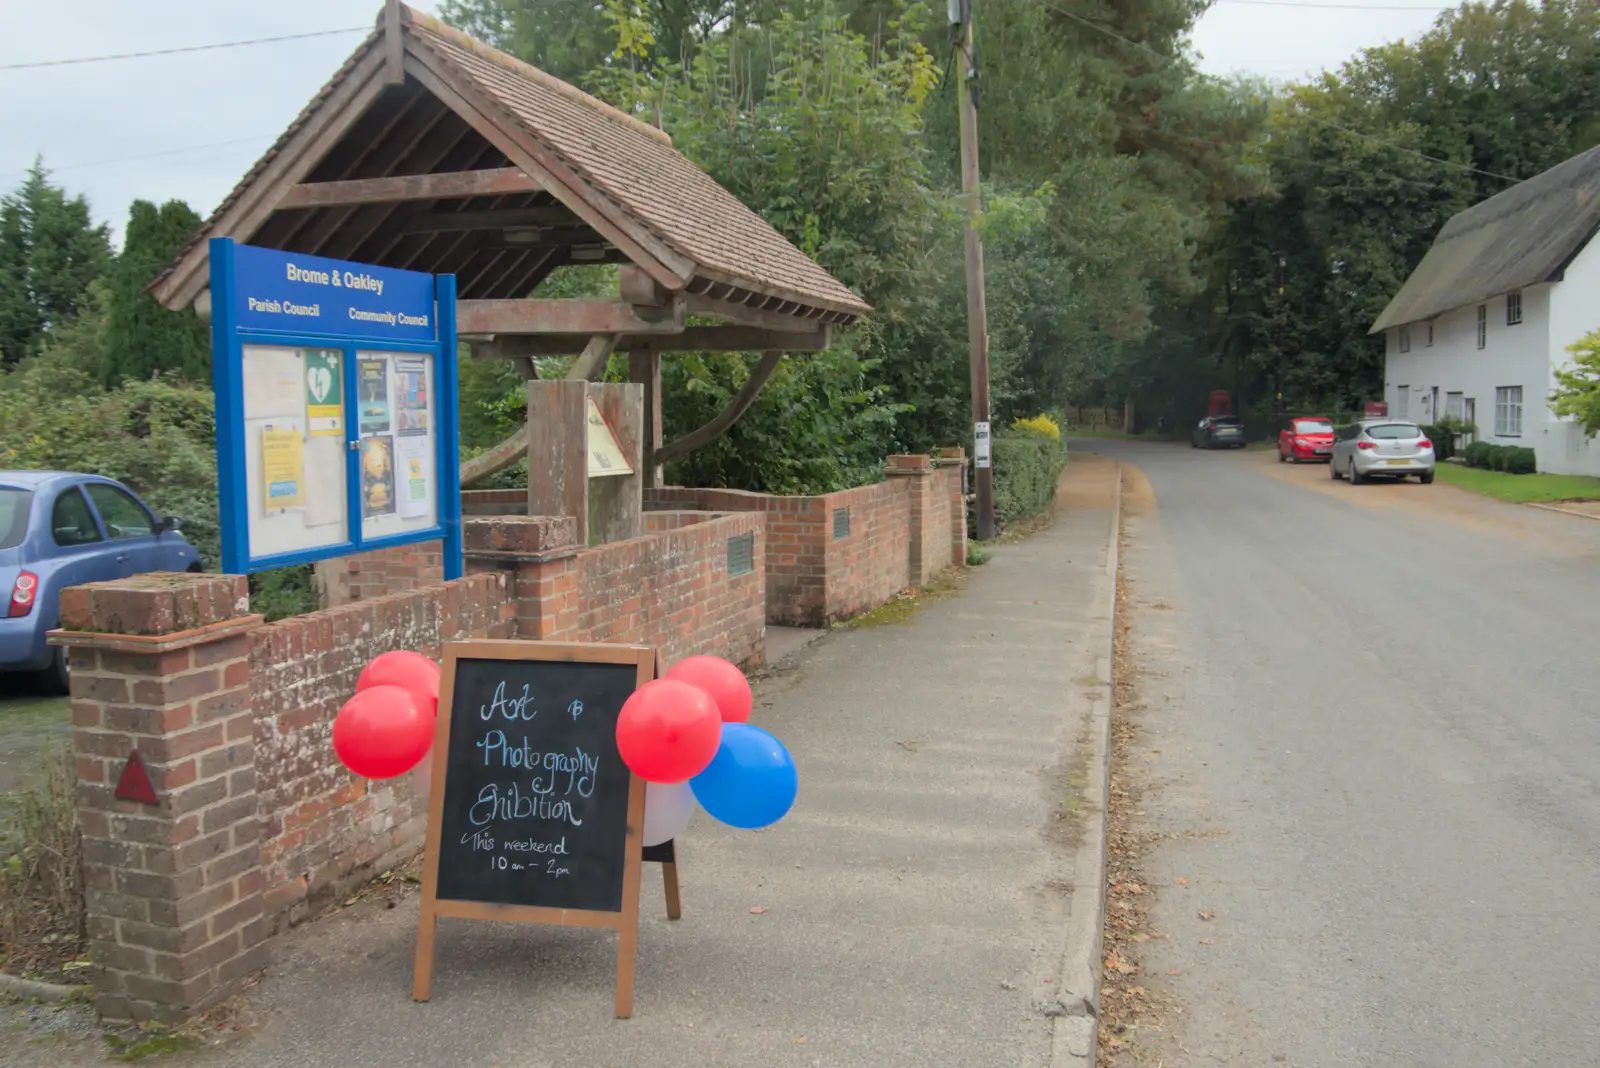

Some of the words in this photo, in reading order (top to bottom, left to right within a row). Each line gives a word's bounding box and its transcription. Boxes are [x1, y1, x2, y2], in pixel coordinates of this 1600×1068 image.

[286, 263, 330, 286] Brome
[331, 270, 342, 286] &
[343, 271, 384, 296] Oakley
[248, 297, 281, 313] Parish
[282, 301, 320, 317] Council
[348, 307, 396, 326] Community
[397, 315, 428, 327] Council
[480, 680, 537, 721] Art
[476, 729, 600, 798] Photography
[461, 826, 495, 851] This
[504, 836, 571, 855] weekend
